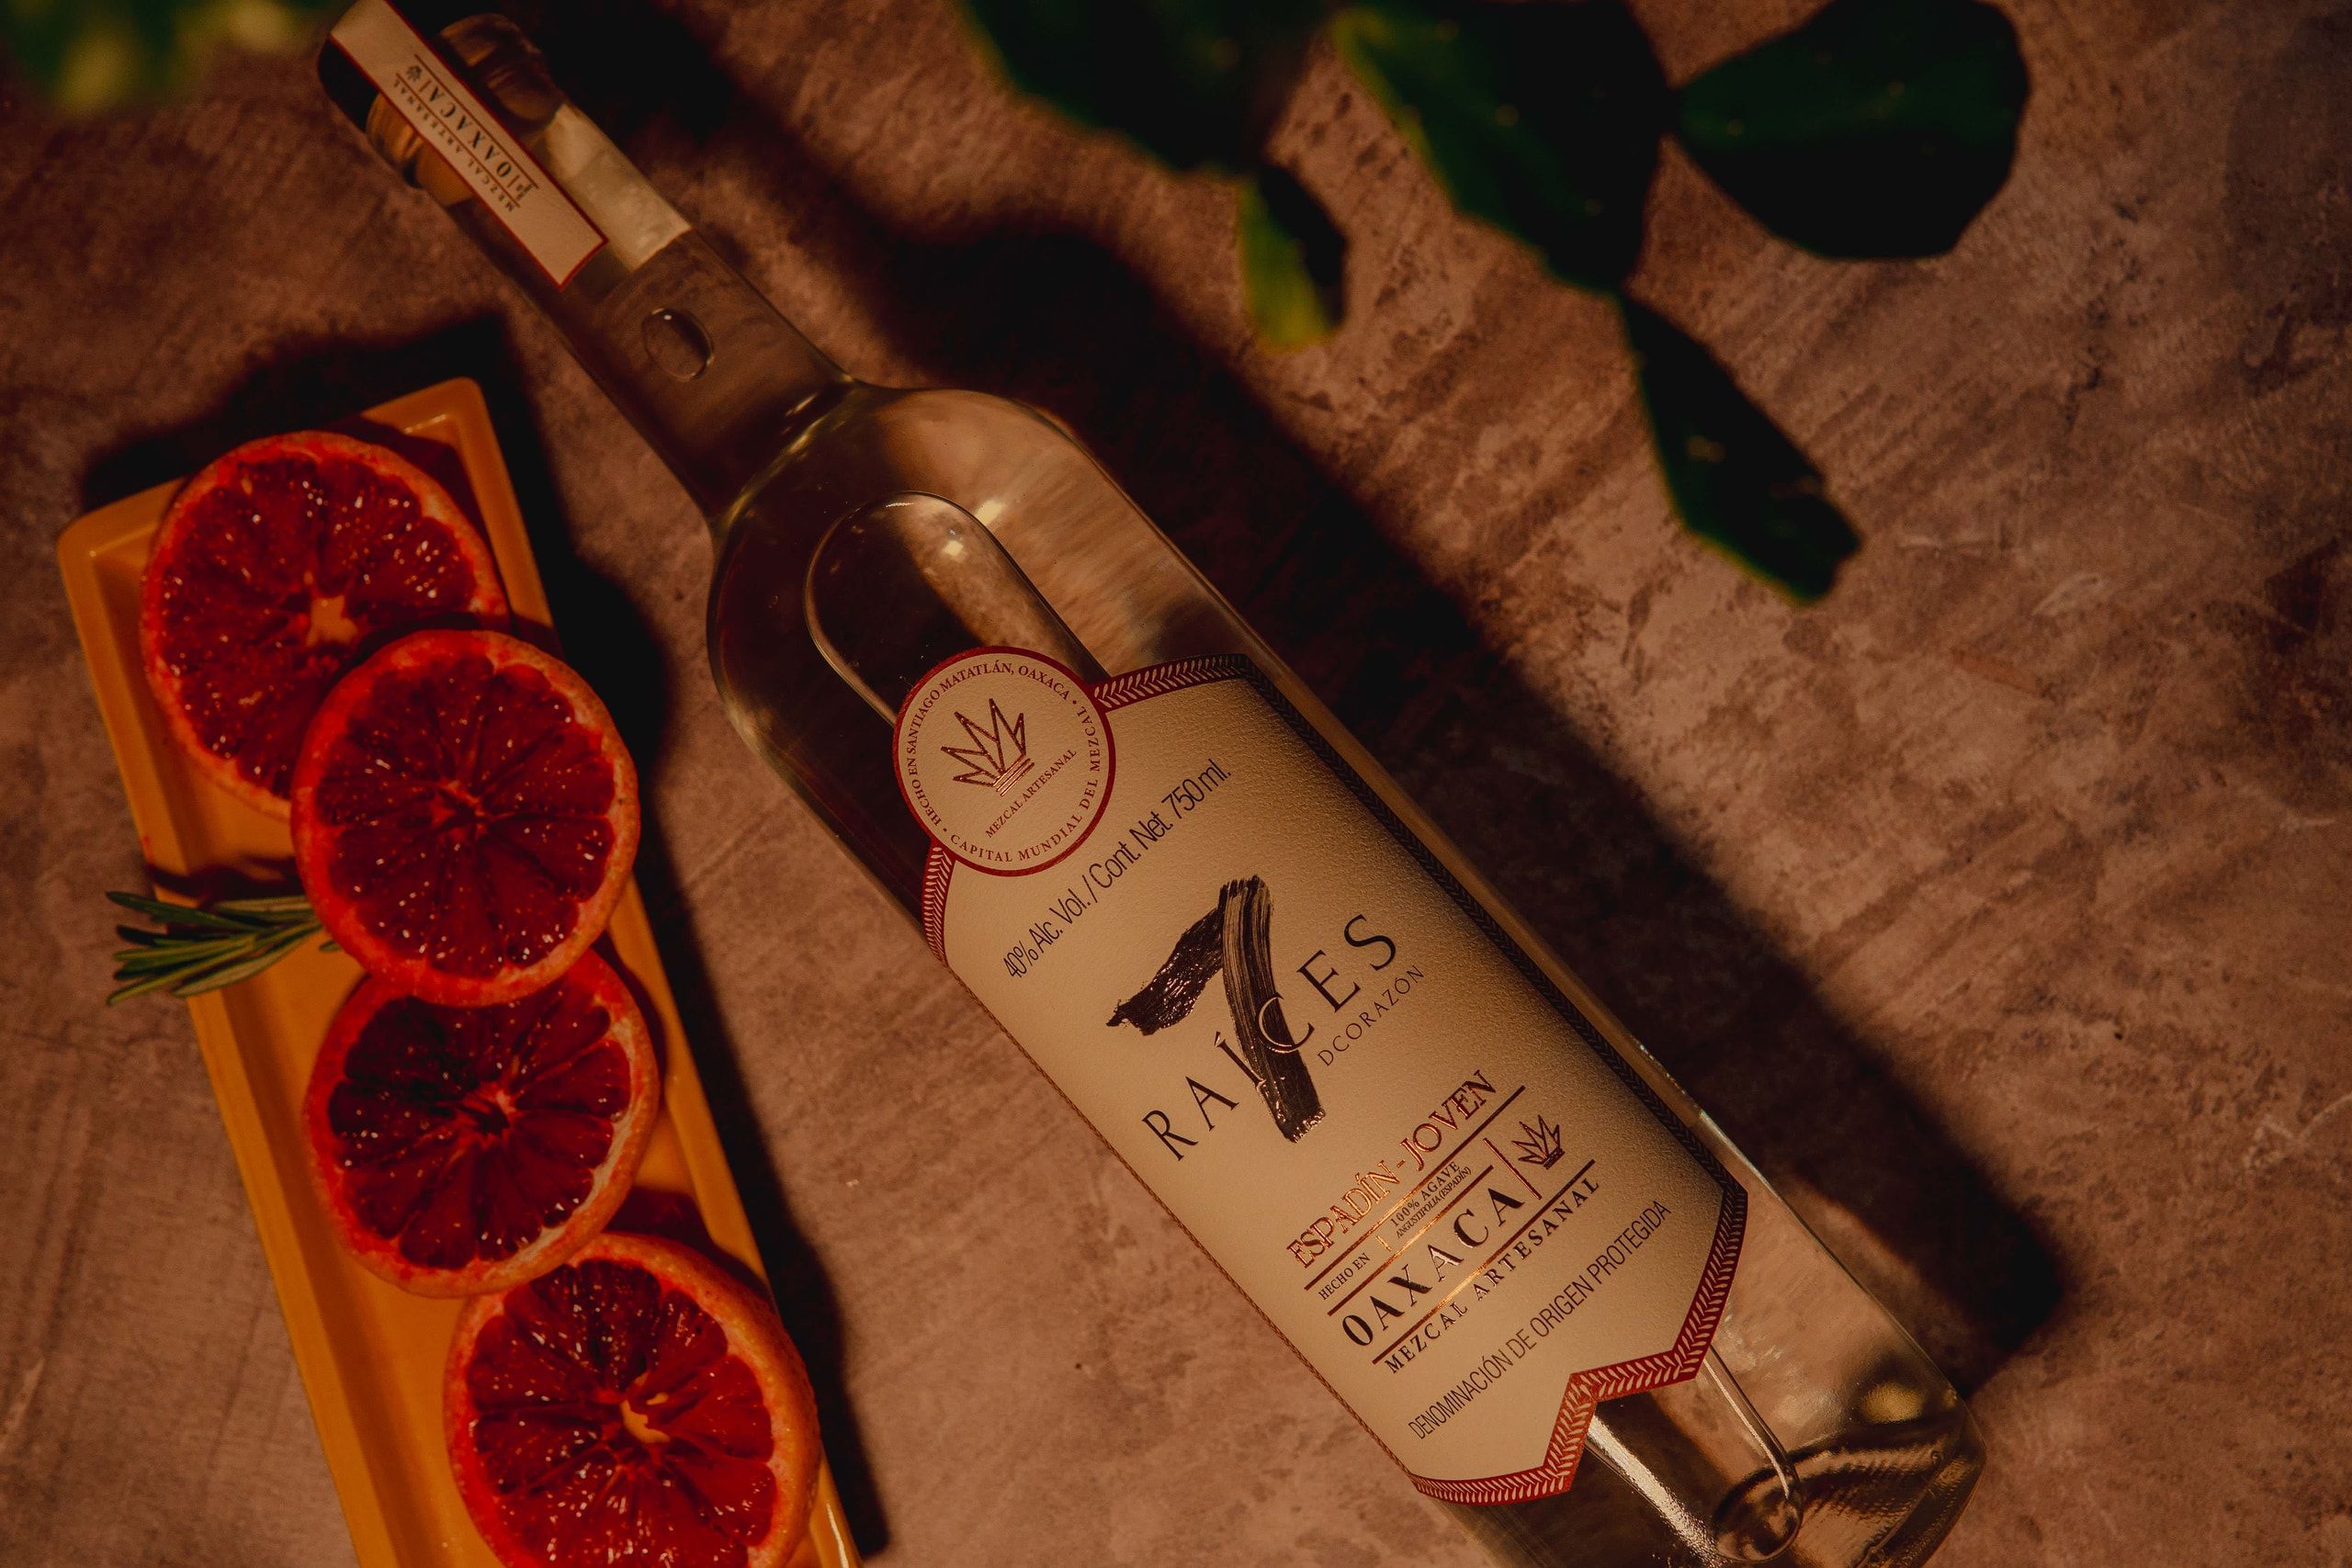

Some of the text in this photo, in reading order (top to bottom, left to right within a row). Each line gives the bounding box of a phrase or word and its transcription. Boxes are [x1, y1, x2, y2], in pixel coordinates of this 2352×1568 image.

[427, 85, 512, 178] OAXACA
[467, 159, 515, 212] MEZCAL
[906, 659, 1070, 828] HECHO EN SANTIAGO MATATLÁN, OAXACA
[950, 705, 1102, 863] CAPITAL MUNDIAL DEL MEZCAL
[1200, 758, 1232, 798] ml.
[984, 749, 1077, 839] MEZCAL ARTESANAL
[1128, 812, 1174, 852] Net.
[1161, 776, 1208, 822] 750
[1048, 884, 1091, 926] Vol.
[1088, 840, 1142, 891] Cont.
[1001, 944, 1040, 979] 40%
[1033, 917, 1064, 950] Alc.
[1105, 874, 1327, 1144] 7
[1140, 913, 1397, 1162] RAÍCES
[1317, 964, 1425, 1067] DCORAZÓN
[1286, 1159, 1401, 1269] ESPADÍN
[1399, 1069, 1498, 1171] JOVEN
[1390, 1161, 1461, 1228] 100% AGAVE
[1395, 1166, 1472, 1239] ANGUSTIFOLIA (ESPADÍN)
[1317, 1252, 1371, 1301] HECHO EN
[1341, 1187, 1526, 1347] OAXACA
[1384, 1180, 1600, 1373] MEZCAL ARTESANAL
[1408, 1200, 1672, 1439] DENOMINACIÓN DE ORIGEN PROTEGIDA
